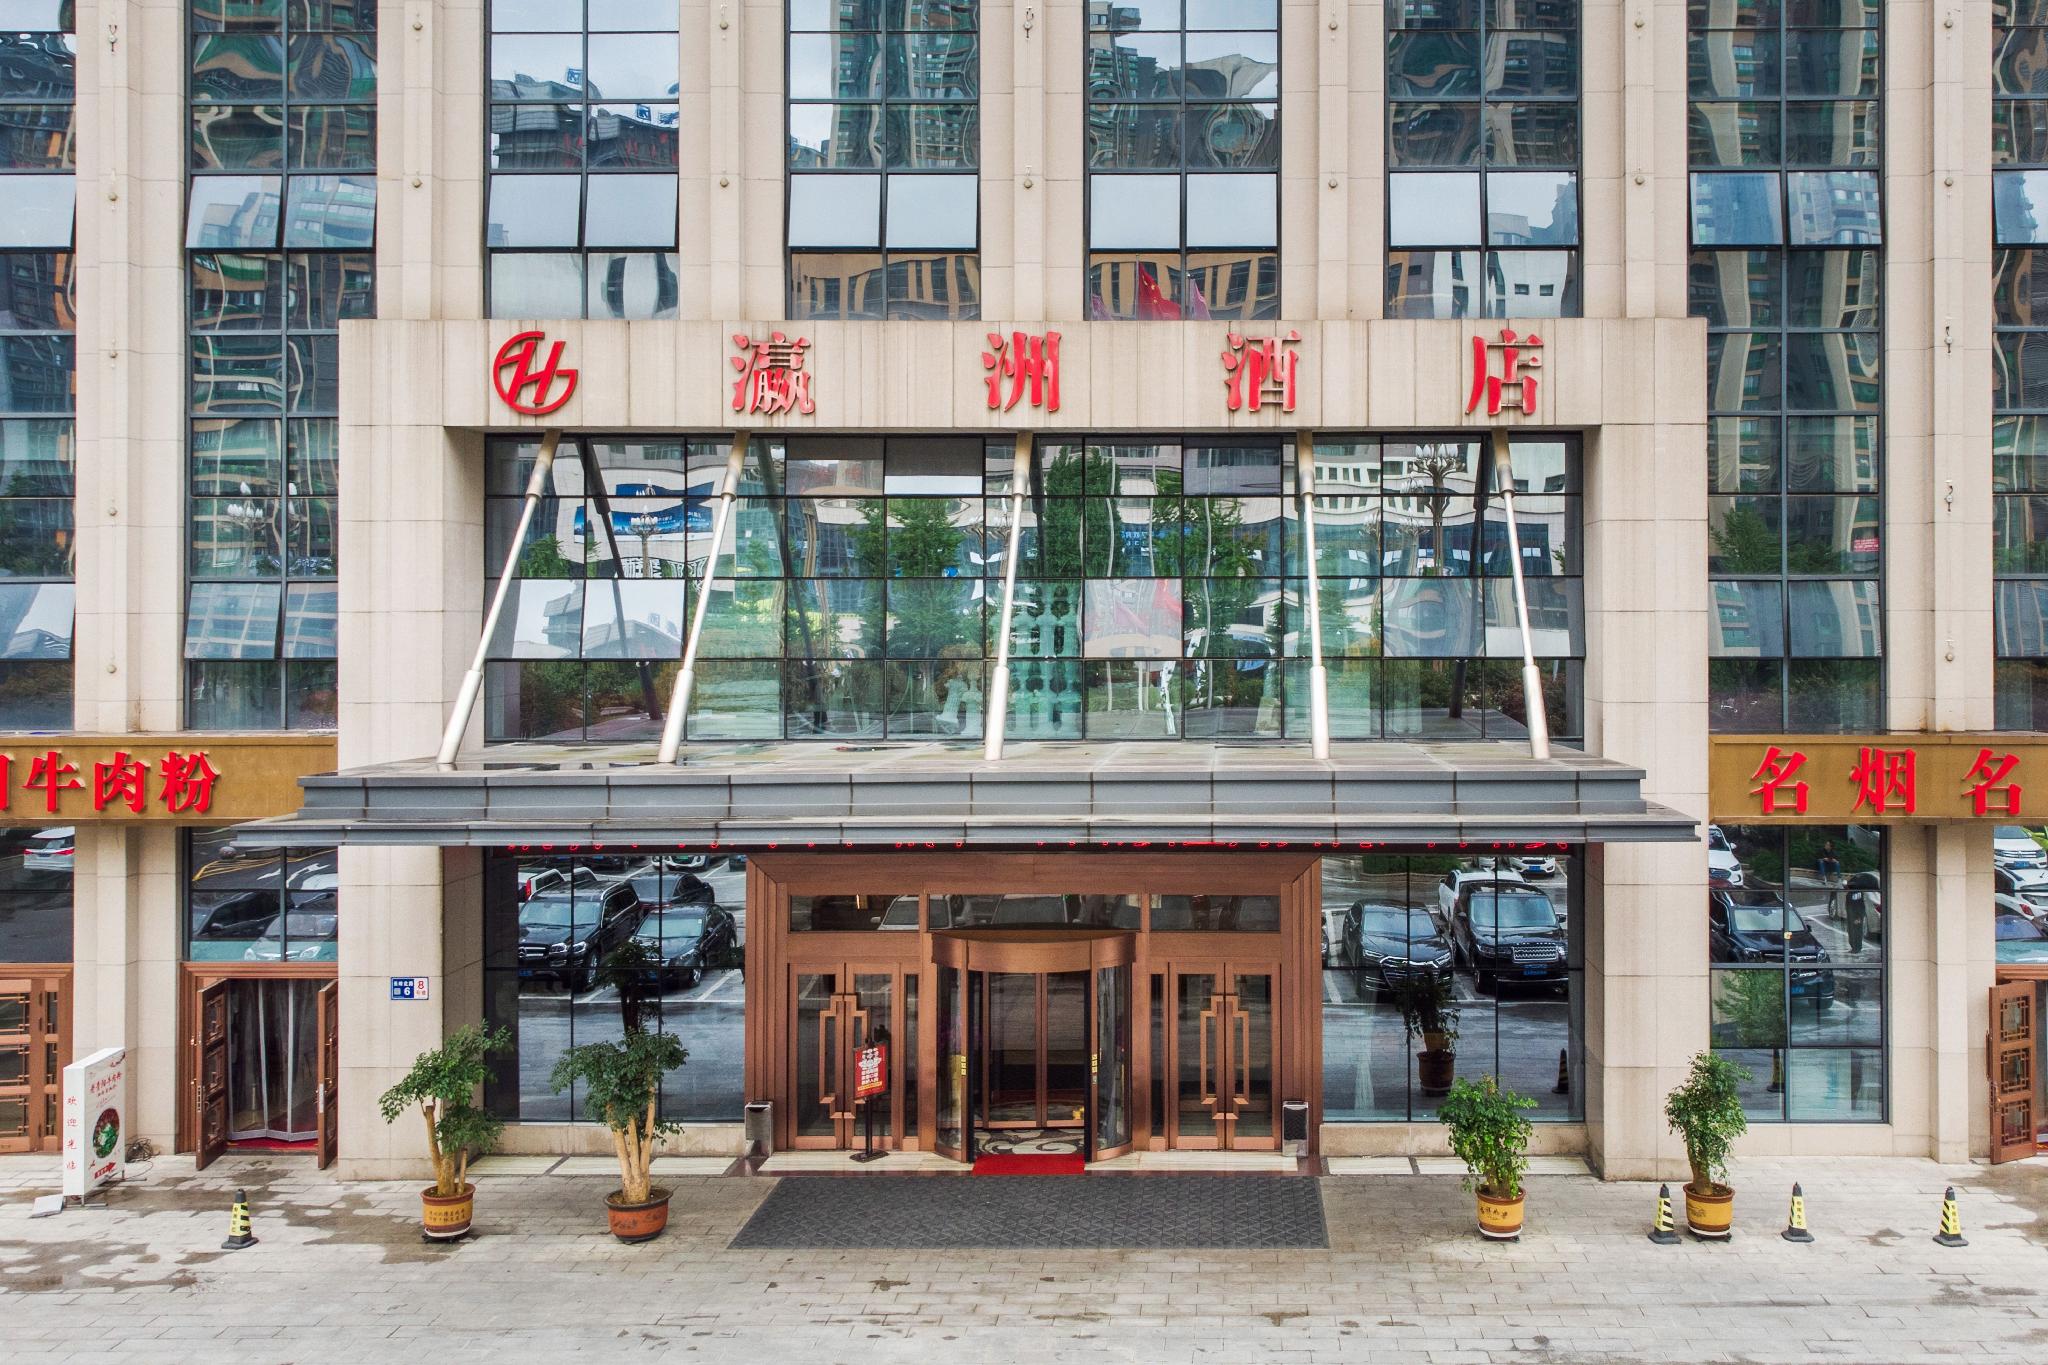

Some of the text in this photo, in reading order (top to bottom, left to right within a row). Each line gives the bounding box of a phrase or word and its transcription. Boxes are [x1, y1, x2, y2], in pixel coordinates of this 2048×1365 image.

[730, 328, 1544, 416] 瀛洲酒店
[0, 751, 220, 813] 牛肉粉
[1749, 745, 2023, 815] 名烟名
[404, 987, 411, 996] 6
[66, 1095, 78, 1170] 欢迎光临
